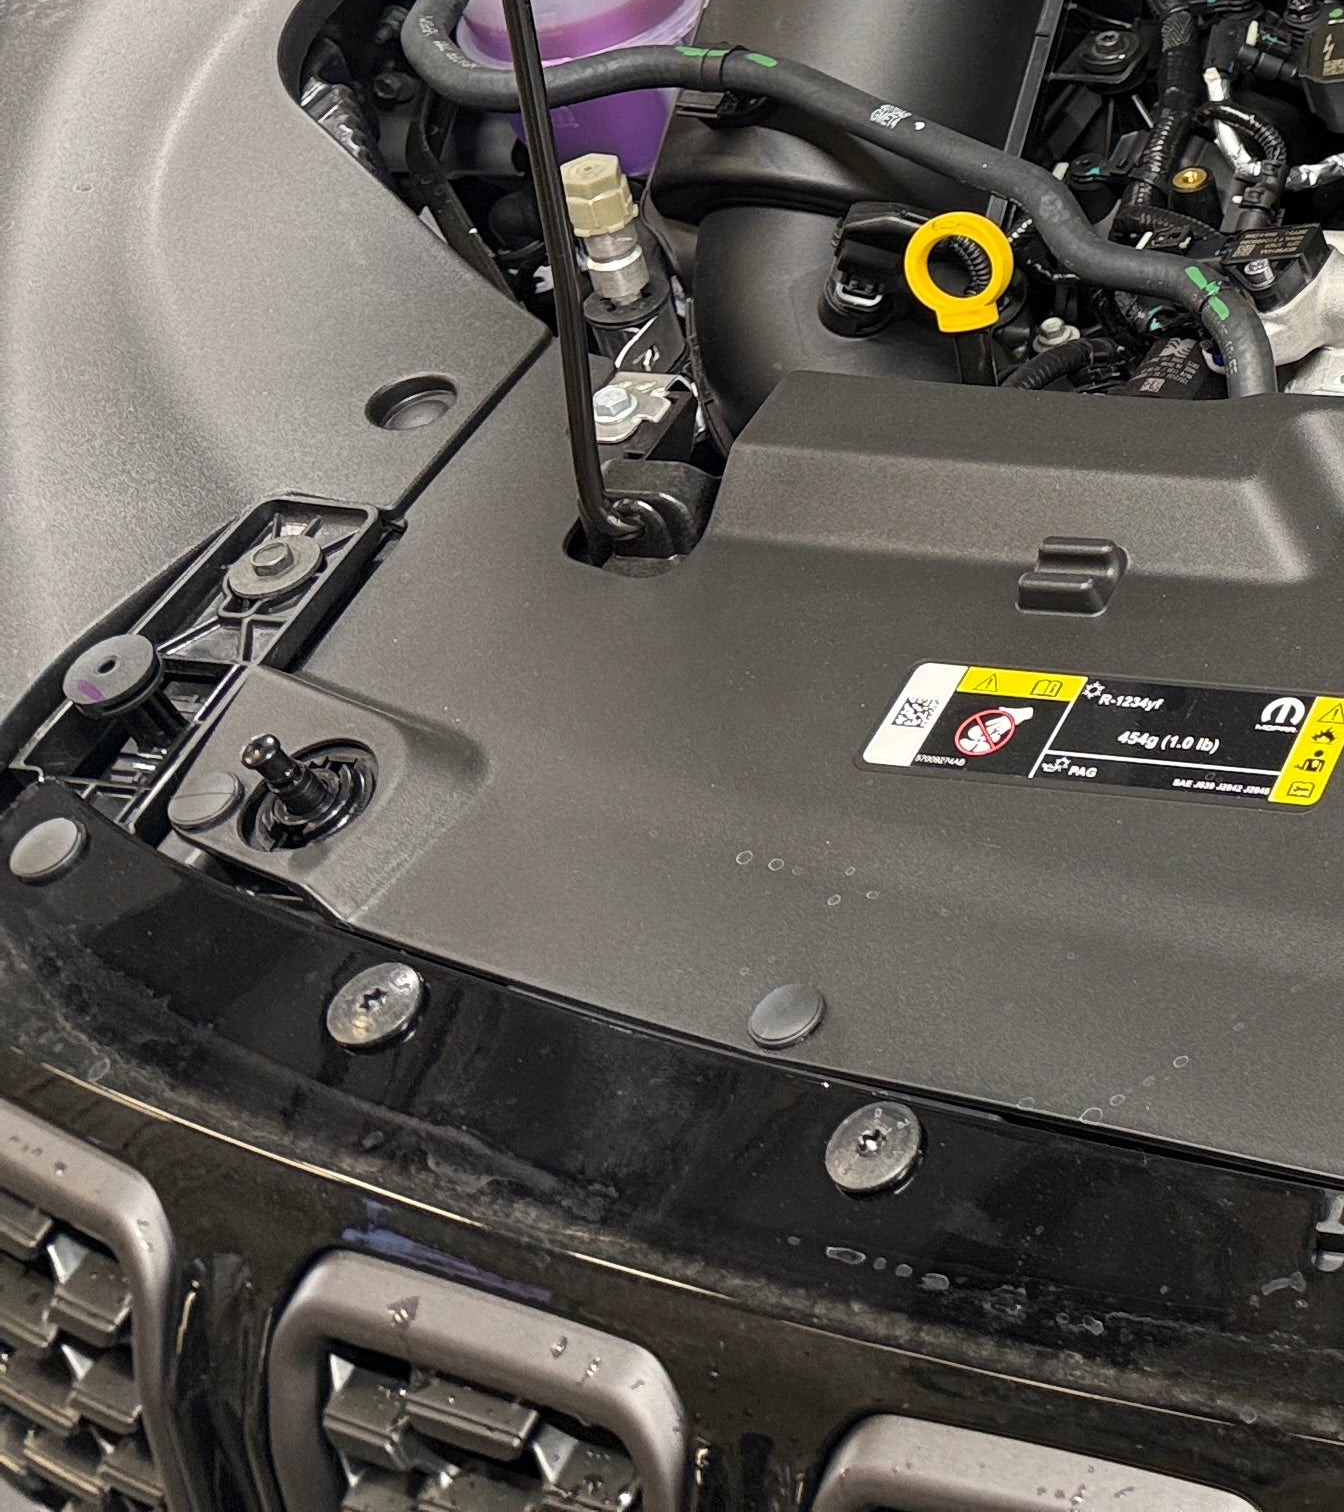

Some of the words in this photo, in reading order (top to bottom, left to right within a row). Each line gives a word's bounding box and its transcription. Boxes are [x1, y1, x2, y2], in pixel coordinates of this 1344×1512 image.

[1099, 694, 1165, 712] R-1234yf
[1117, 731, 1159, 750] 454g
[1161, 734, 1194, 751] (1.0
[1195, 738, 1220, 754] lb)
[1067, 765, 1098, 778] PAG
[1172, 778, 1193, 788] SAE
